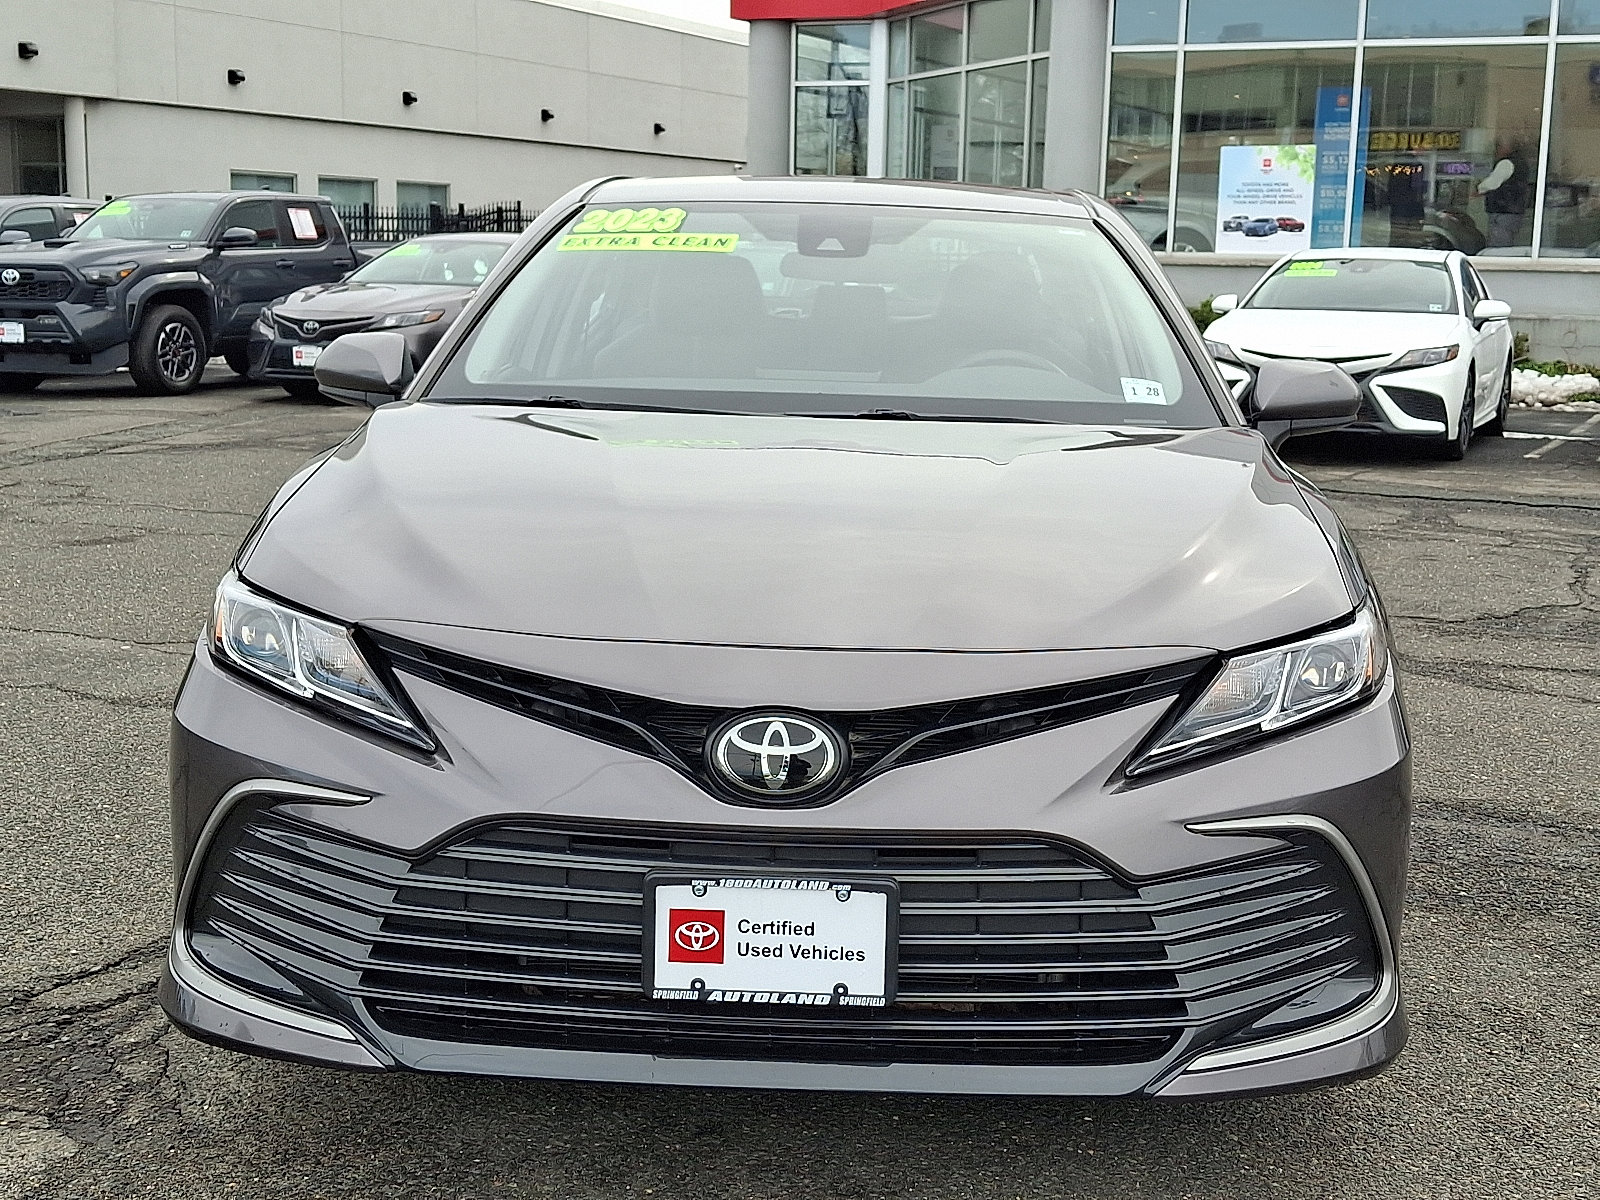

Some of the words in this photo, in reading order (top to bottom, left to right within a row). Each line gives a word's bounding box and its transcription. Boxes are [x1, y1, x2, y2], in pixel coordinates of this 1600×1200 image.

[572, 207, 687, 233] 2023
[562, 235, 640, 248] EXTRA
[651, 235, 732, 248] CLEAN
[1131, 386, 1138, 396] 1
[1146, 386, 1160, 397] 28
[737, 919, 815, 937] Certified
[737, 941, 783, 958] Used
[789, 943, 866, 962] Vehicles
[652, 989, 699, 1000] SPRINGFIELD
[706, 990, 832, 1006] AUTOLAND
[839, 995, 886, 1007] SPRINGFIELD
